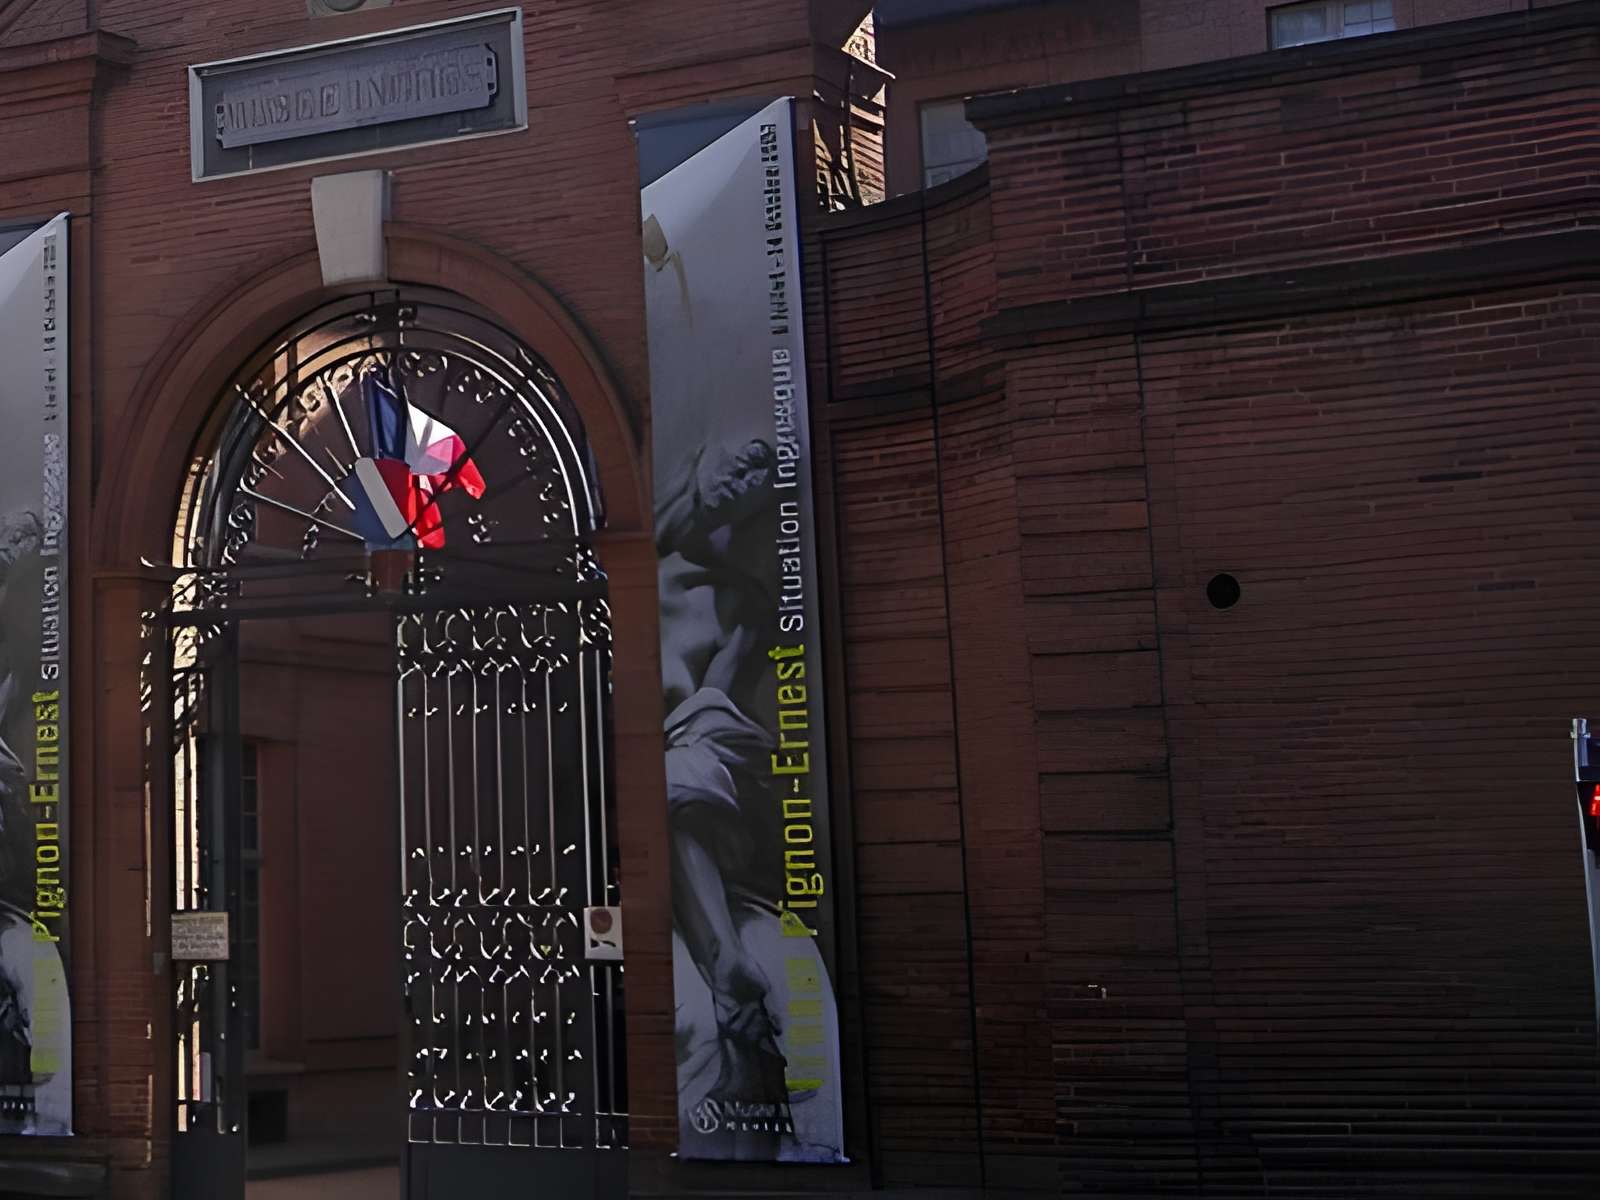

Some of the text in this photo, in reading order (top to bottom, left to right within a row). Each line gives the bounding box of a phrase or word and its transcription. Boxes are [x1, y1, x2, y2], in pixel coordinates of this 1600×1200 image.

[776, 501, 804, 631] Situation
[29, 689, 66, 941] Pignon-Ernest
[768, 644, 824, 937] Pignon-Ernest
